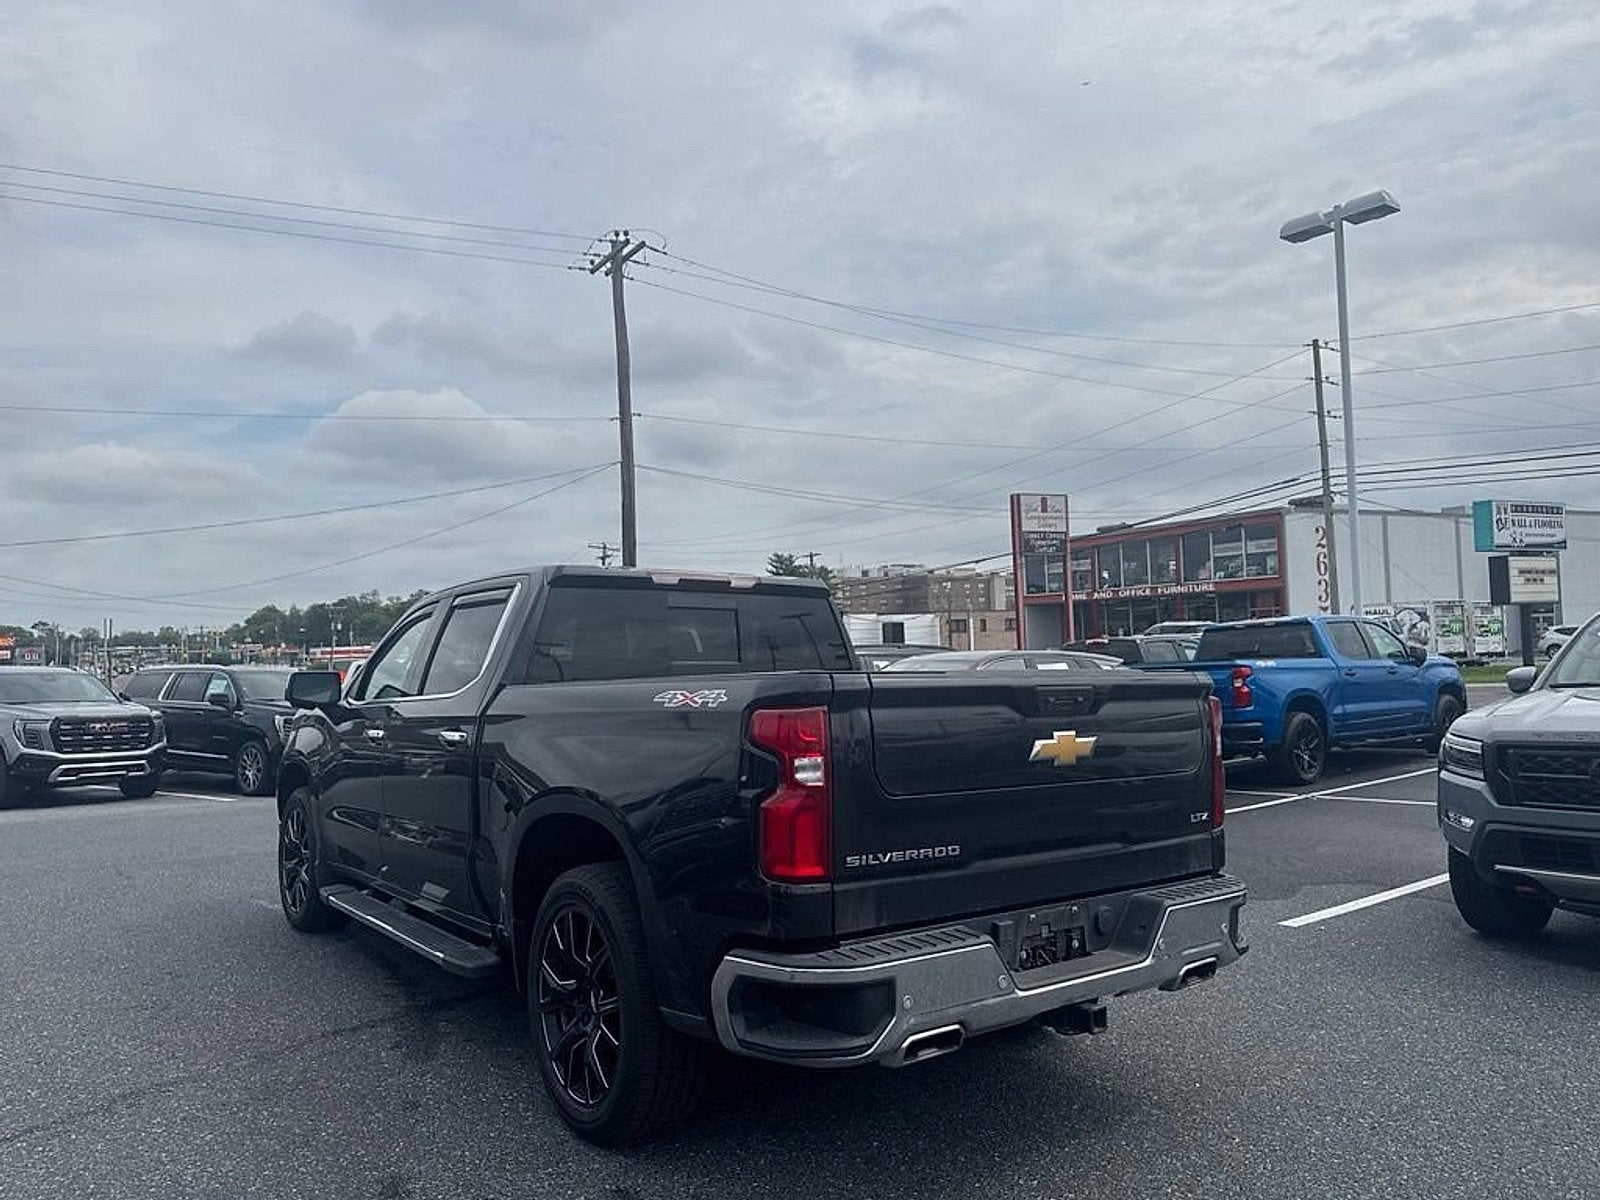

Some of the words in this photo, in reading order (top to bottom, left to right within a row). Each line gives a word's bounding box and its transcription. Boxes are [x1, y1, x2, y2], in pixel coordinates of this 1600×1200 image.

[1315, 525, 1330, 612] 263
[1093, 590, 1113, 600] AND
[1118, 587, 1151, 598] OFFICE
[1157, 582, 1215, 596] FURNITURE
[845, 845, 961, 867] SILVERADO
